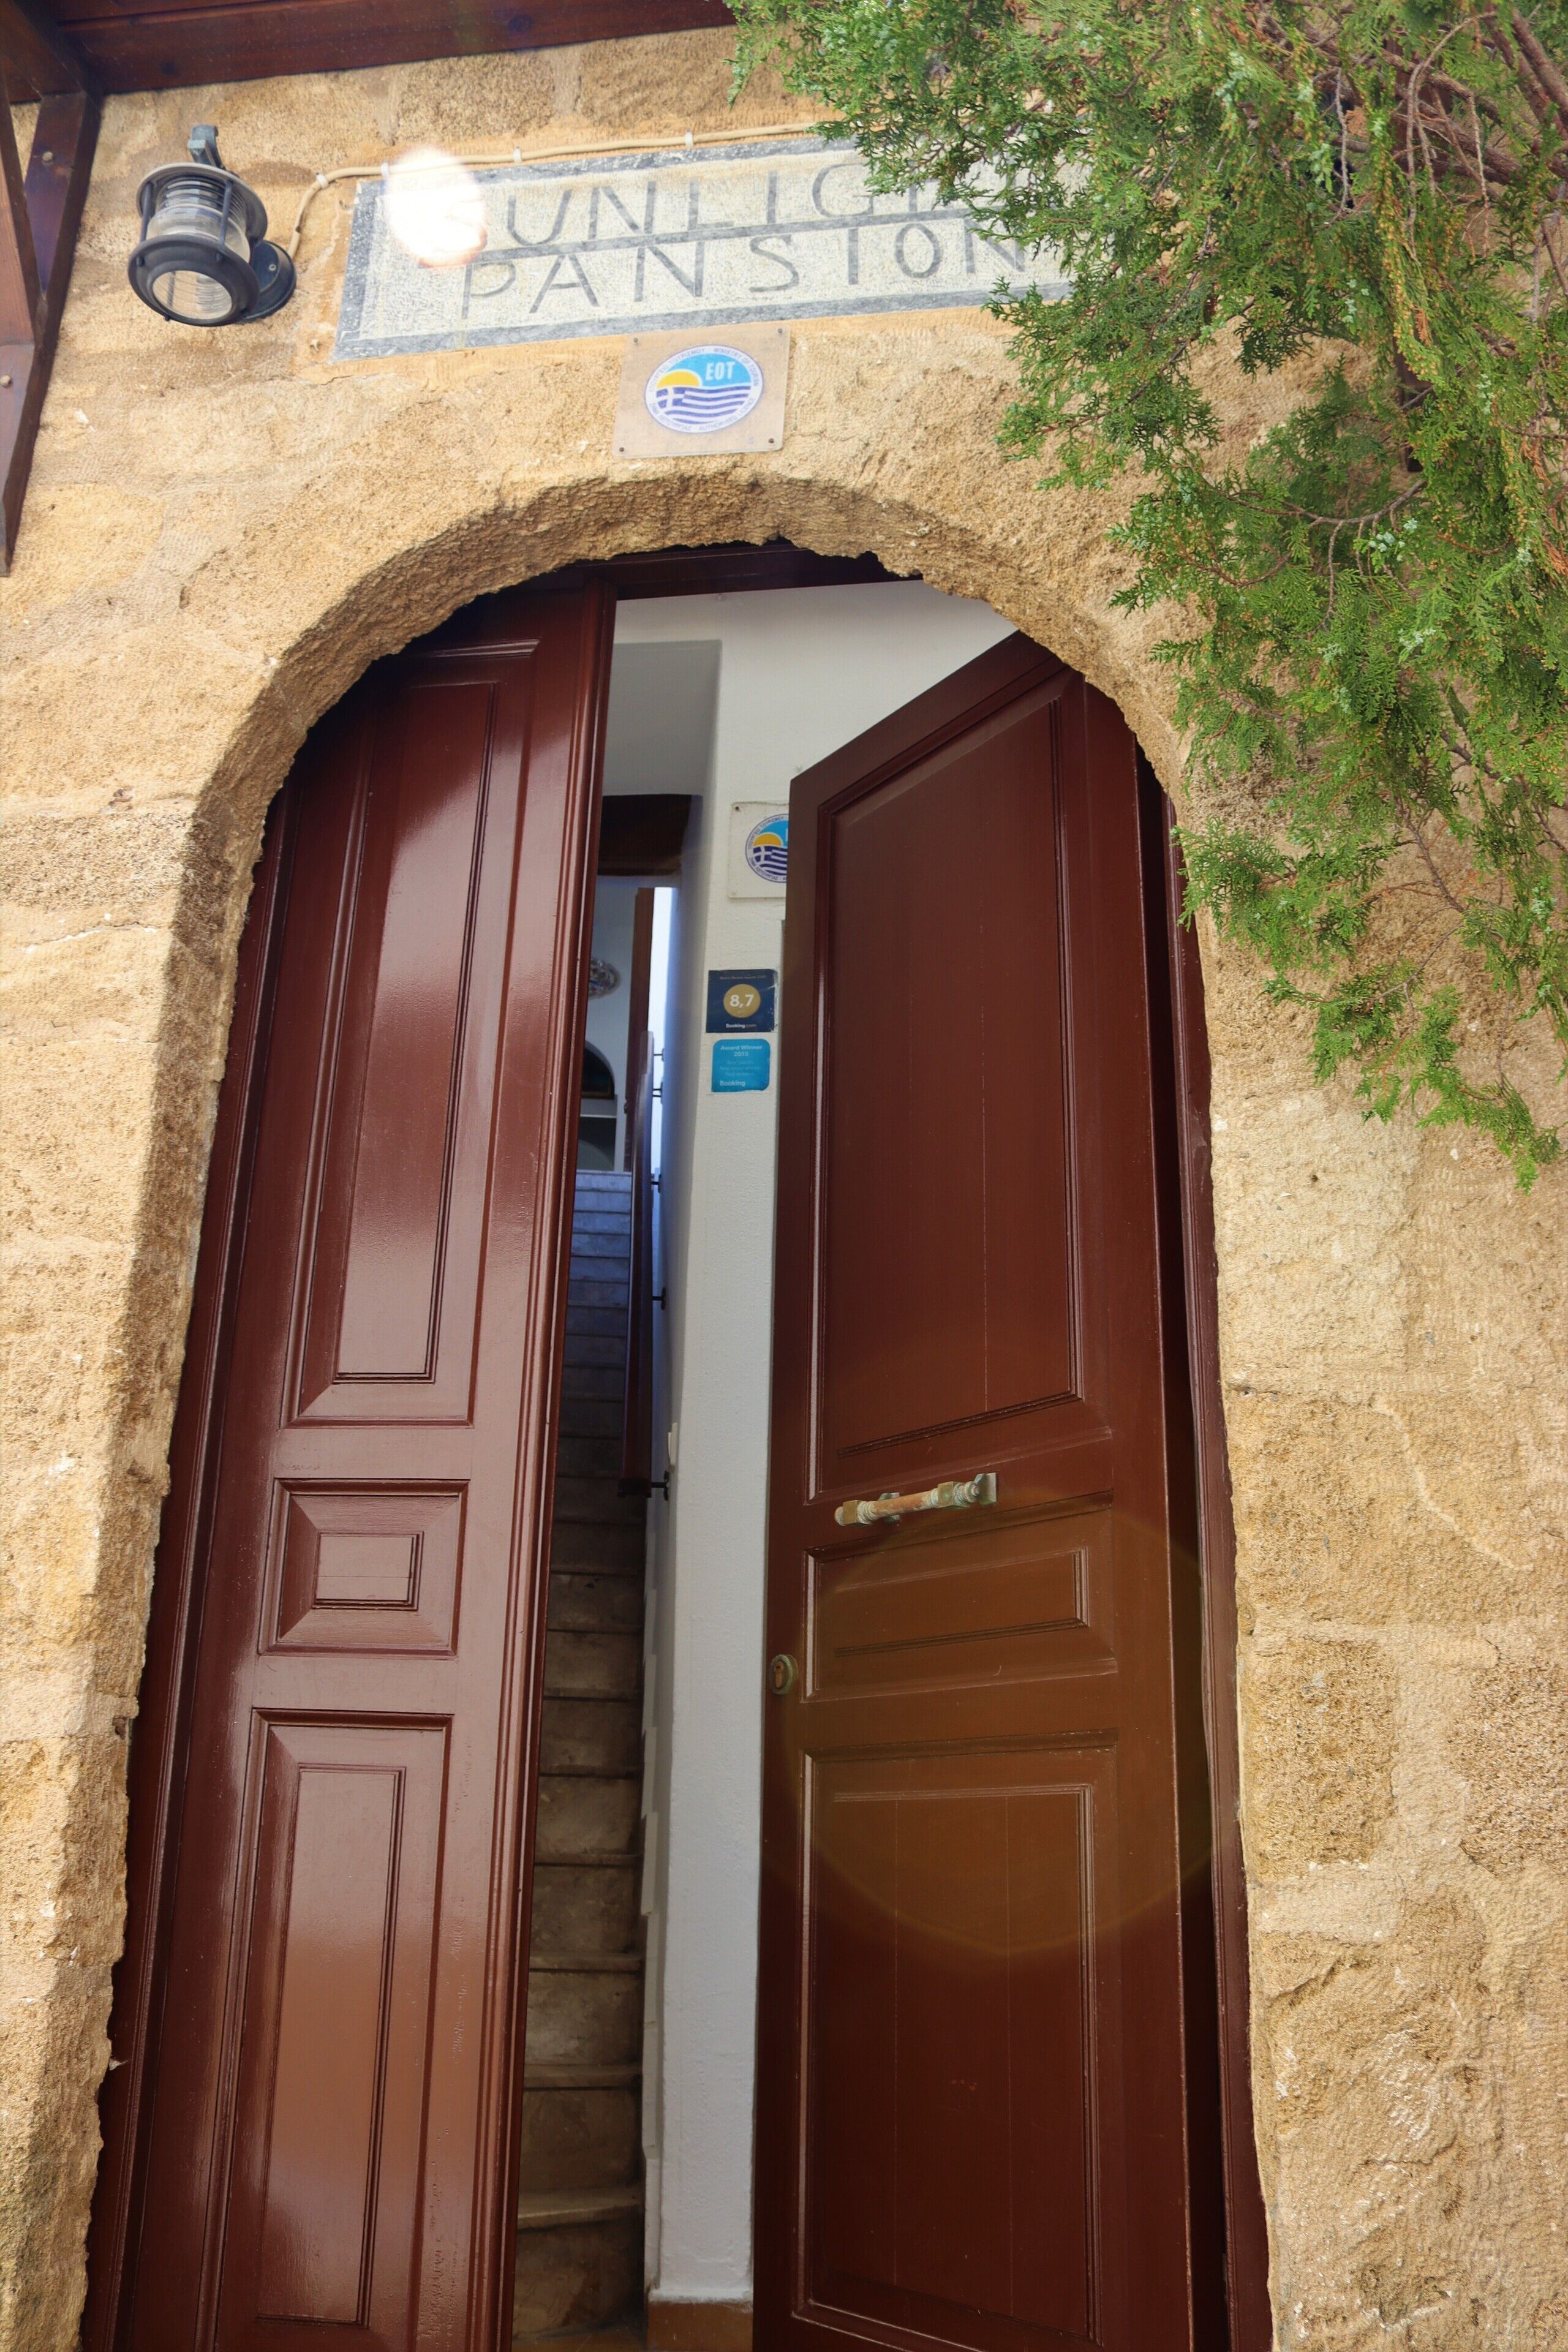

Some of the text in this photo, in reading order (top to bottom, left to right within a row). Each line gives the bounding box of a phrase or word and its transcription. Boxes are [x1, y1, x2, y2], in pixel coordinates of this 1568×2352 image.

[461, 217, 1026, 320] PANSION
[705, 361, 737, 381] EOT
[729, 994, 755, 1008] 8,7
